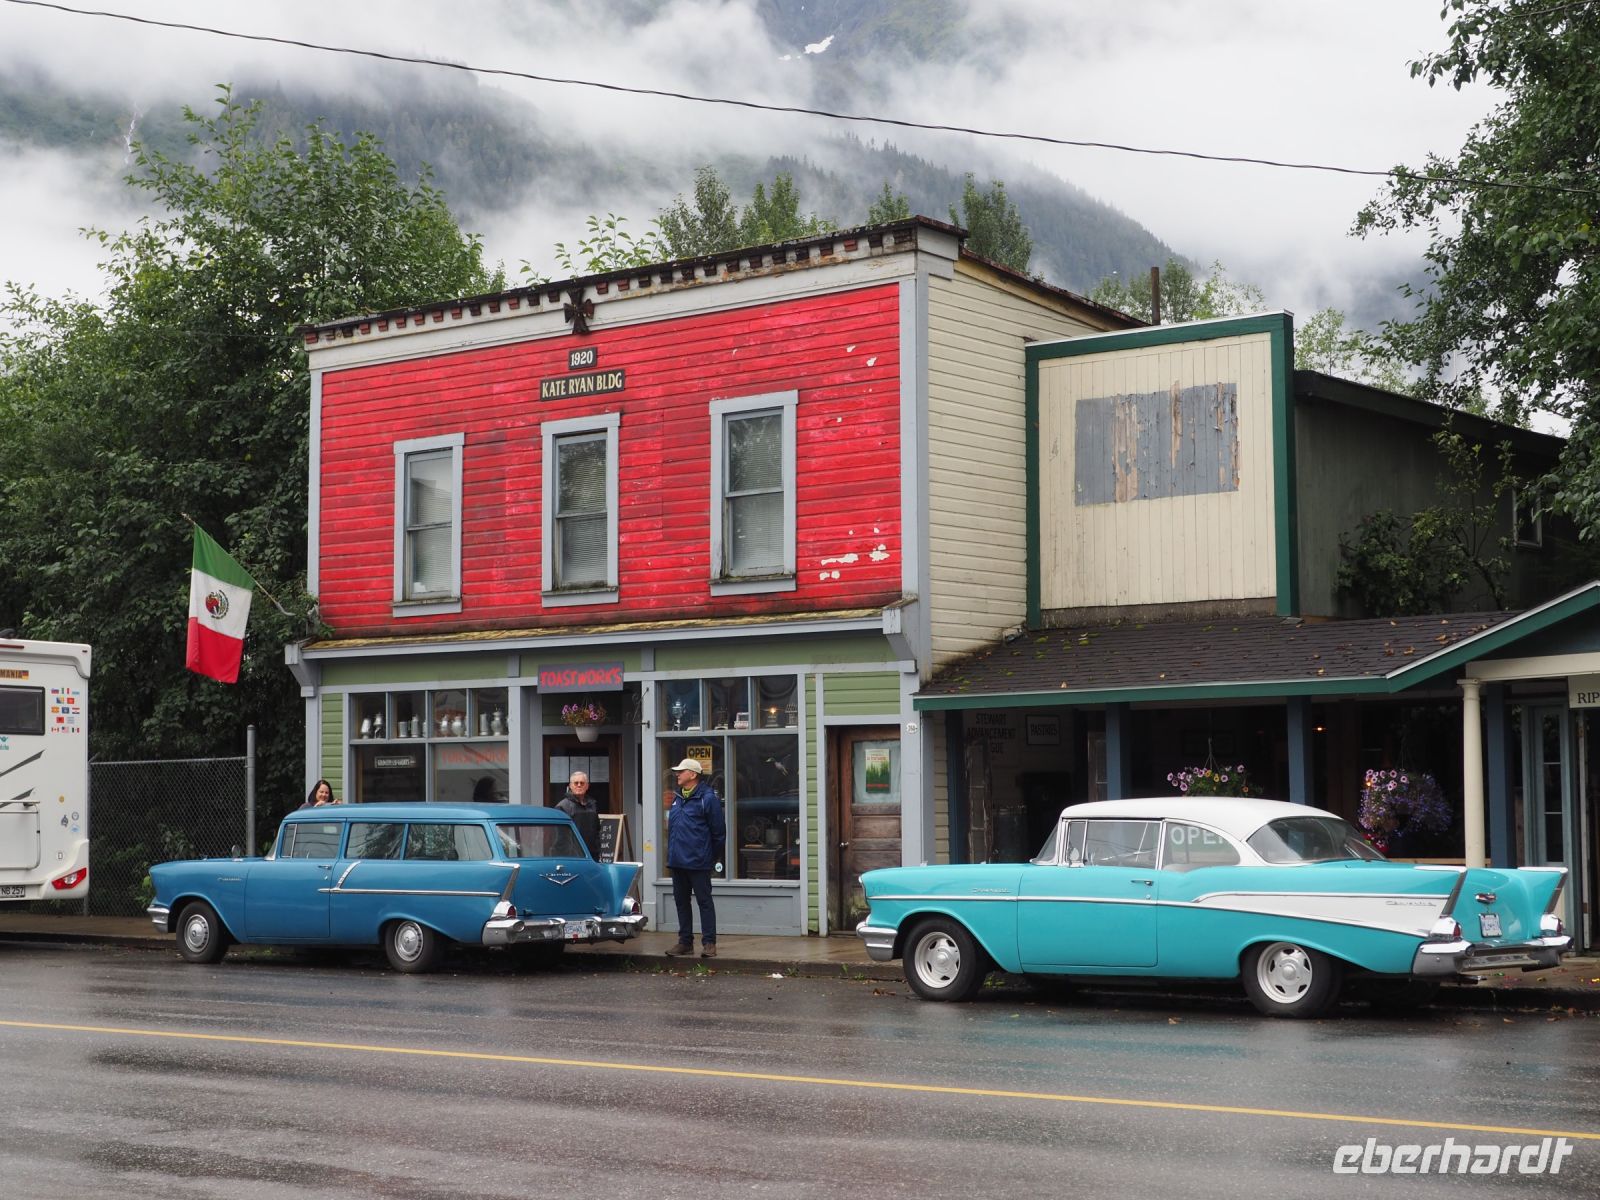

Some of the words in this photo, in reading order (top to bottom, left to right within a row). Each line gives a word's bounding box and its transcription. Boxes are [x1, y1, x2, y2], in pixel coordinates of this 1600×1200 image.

[570, 350, 594, 367] 1920
[542, 380, 566, 398] KATE
[568, 377, 594, 394] RYAN
[596, 372, 622, 391] BLDG
[688, 747, 711, 759] OPEN
[12, 886, 24, 895] 257
